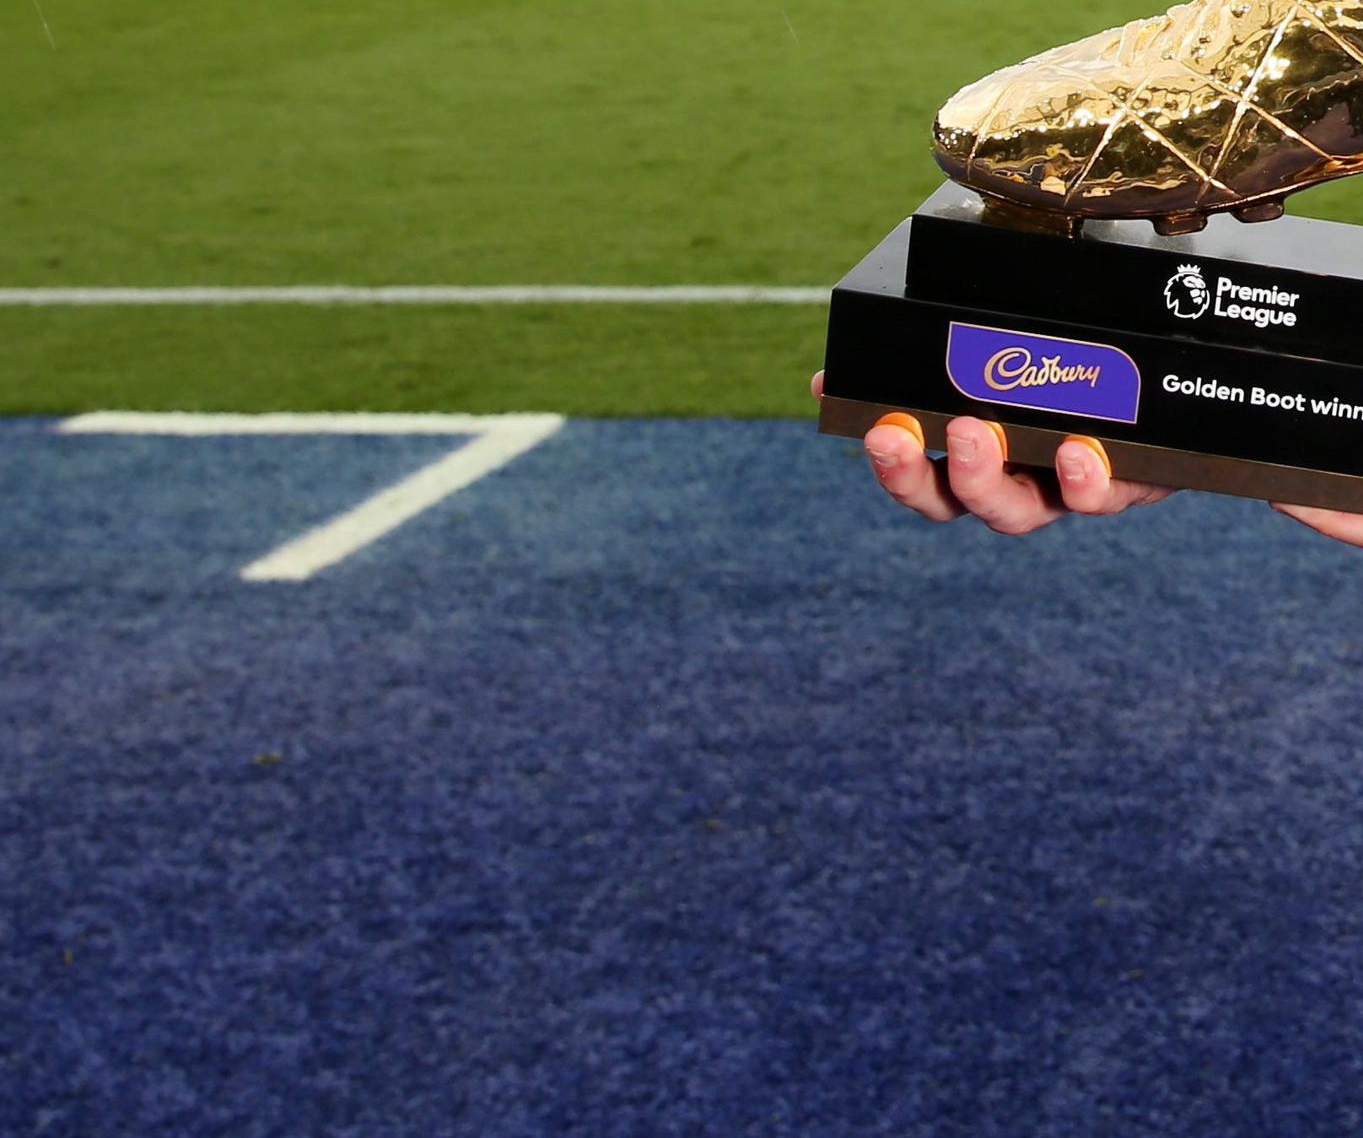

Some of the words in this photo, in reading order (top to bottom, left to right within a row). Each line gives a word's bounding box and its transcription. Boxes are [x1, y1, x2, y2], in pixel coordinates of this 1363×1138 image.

[1216, 277, 1300, 307] Premier
[1214, 296, 1297, 328] League
[984, 347, 1102, 391] Cadbury
[1162, 373, 1245, 405] Golden
[1250, 386, 1306, 414] Boot
